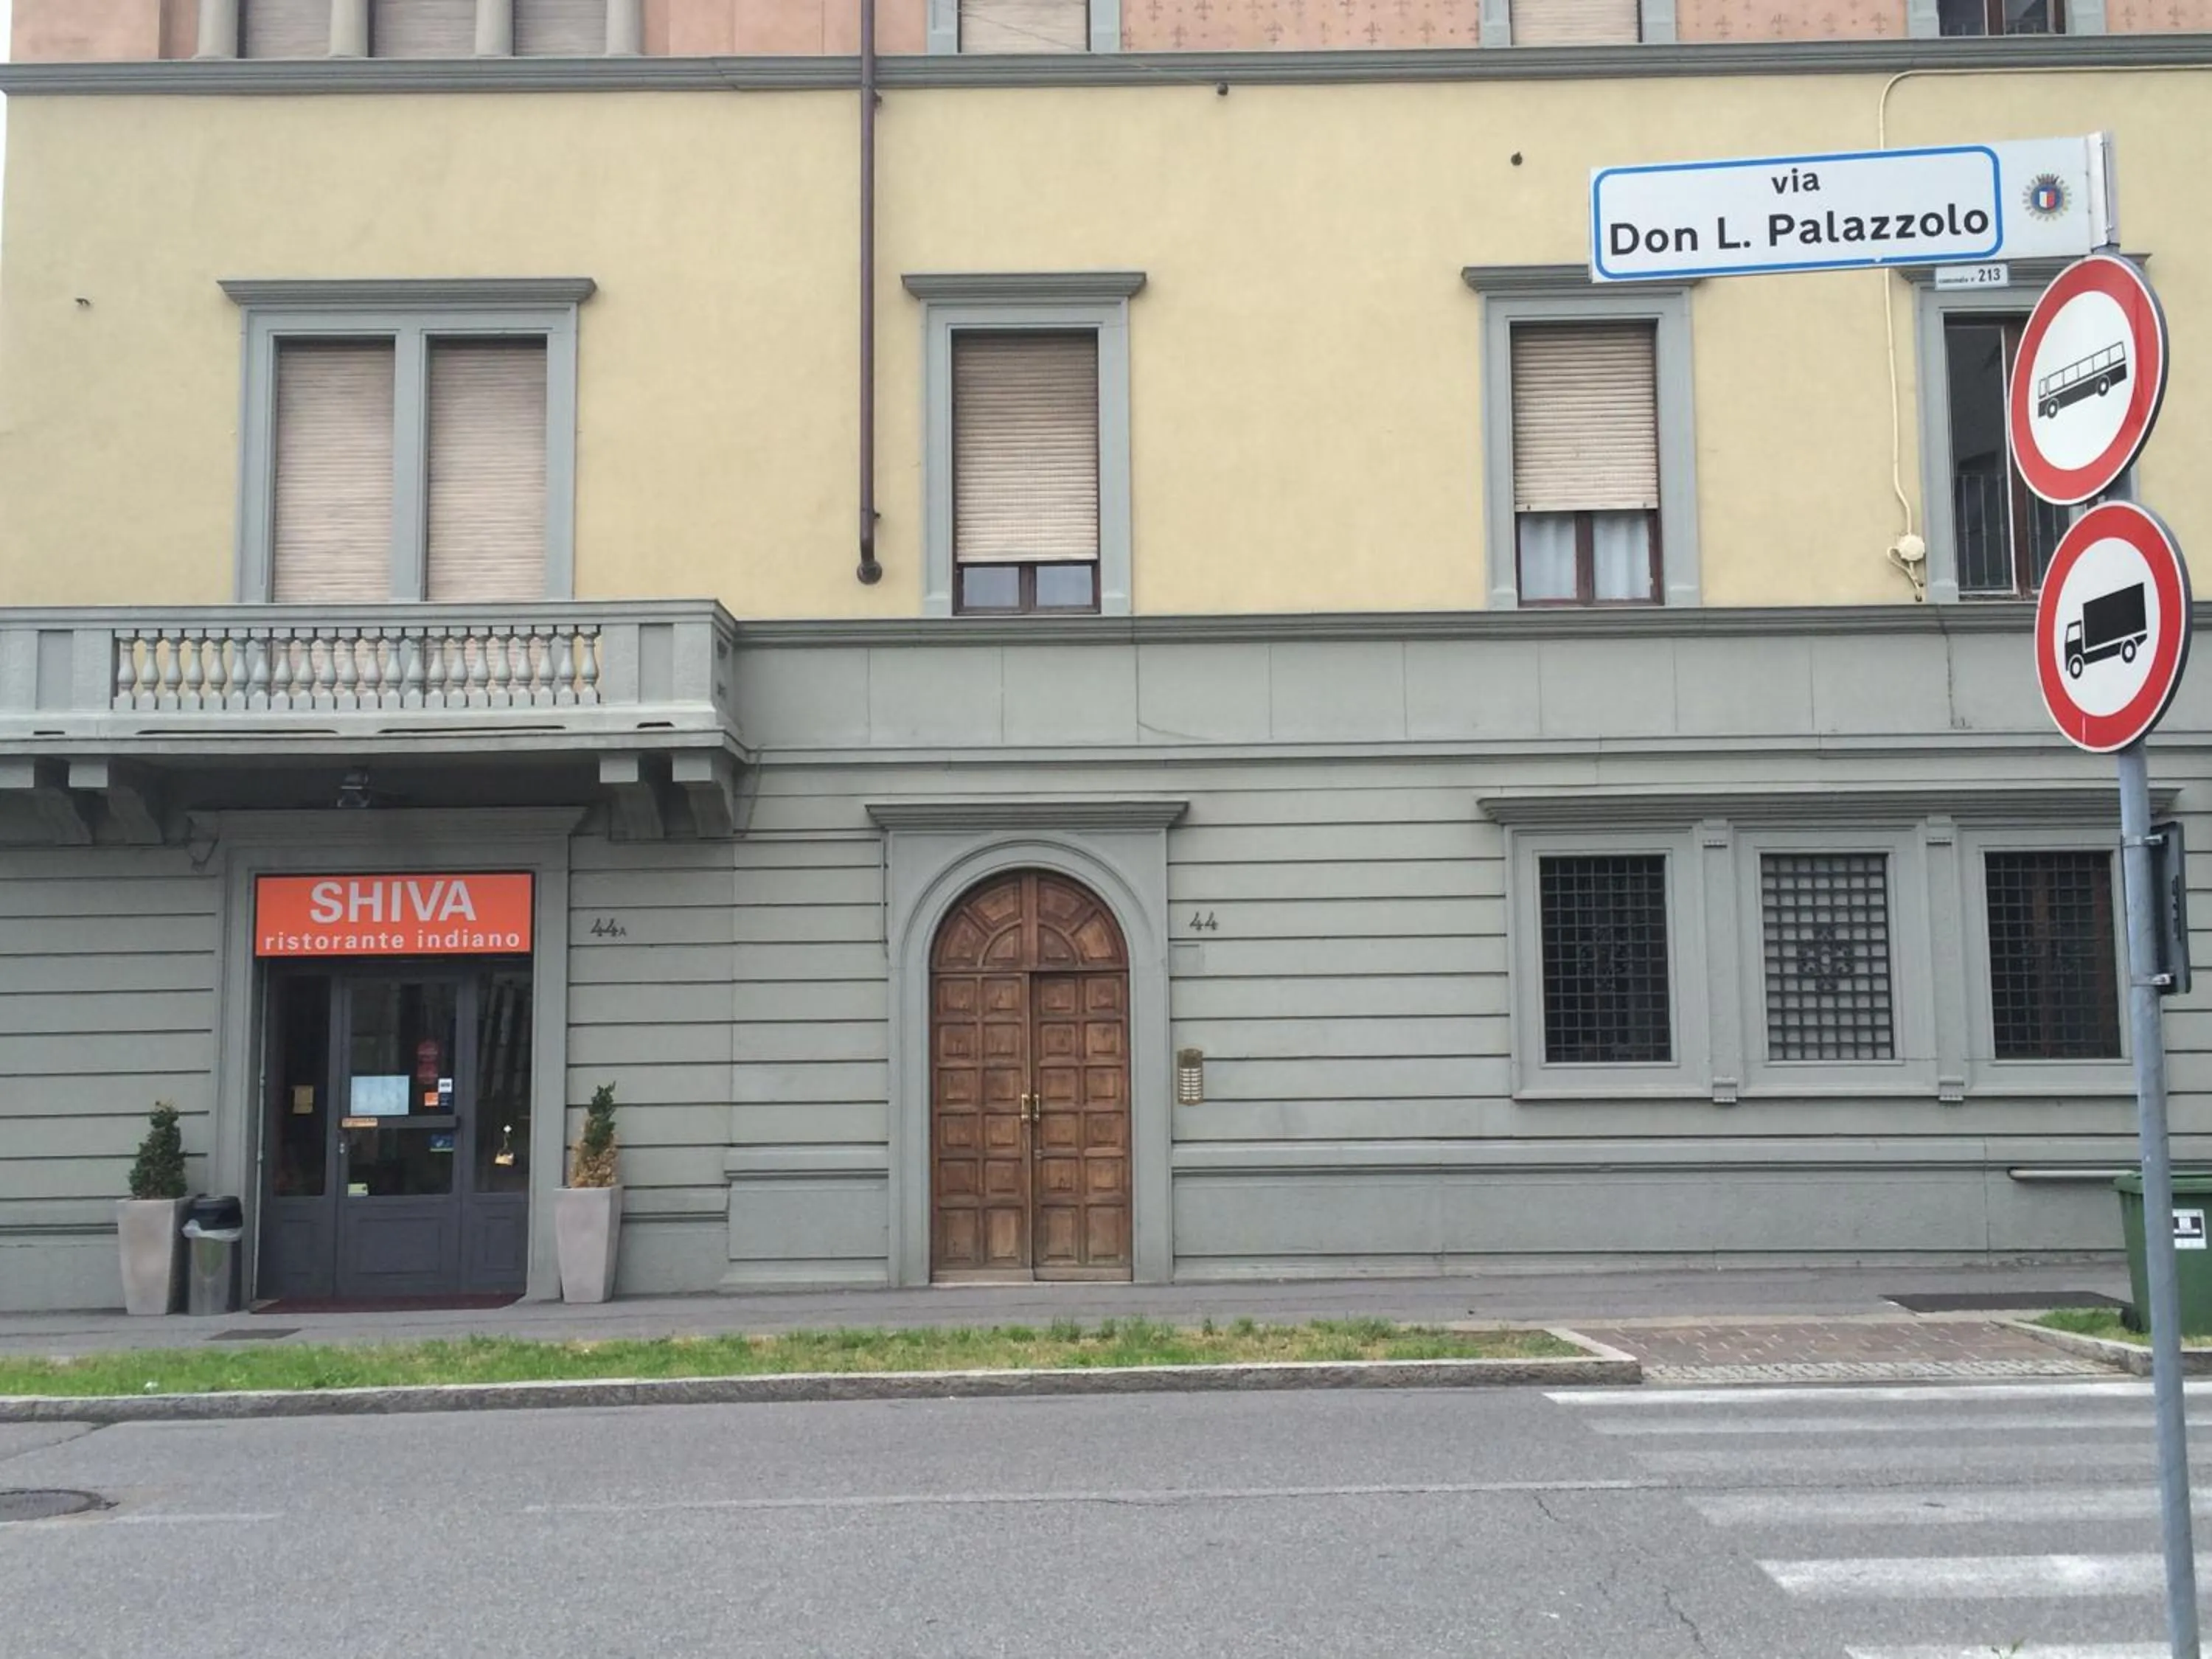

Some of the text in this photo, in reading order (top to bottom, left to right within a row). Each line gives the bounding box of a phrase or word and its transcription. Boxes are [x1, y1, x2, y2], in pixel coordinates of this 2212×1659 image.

[1771, 167, 1820, 194] via
[1610, 203, 1989, 256] Don L. Palazzolo
[1978, 268, 2000, 282] 213
[310, 880, 477, 924] SHIVA
[1189, 911, 1218, 931] 44
[265, 928, 521, 950] ristorante indiano
